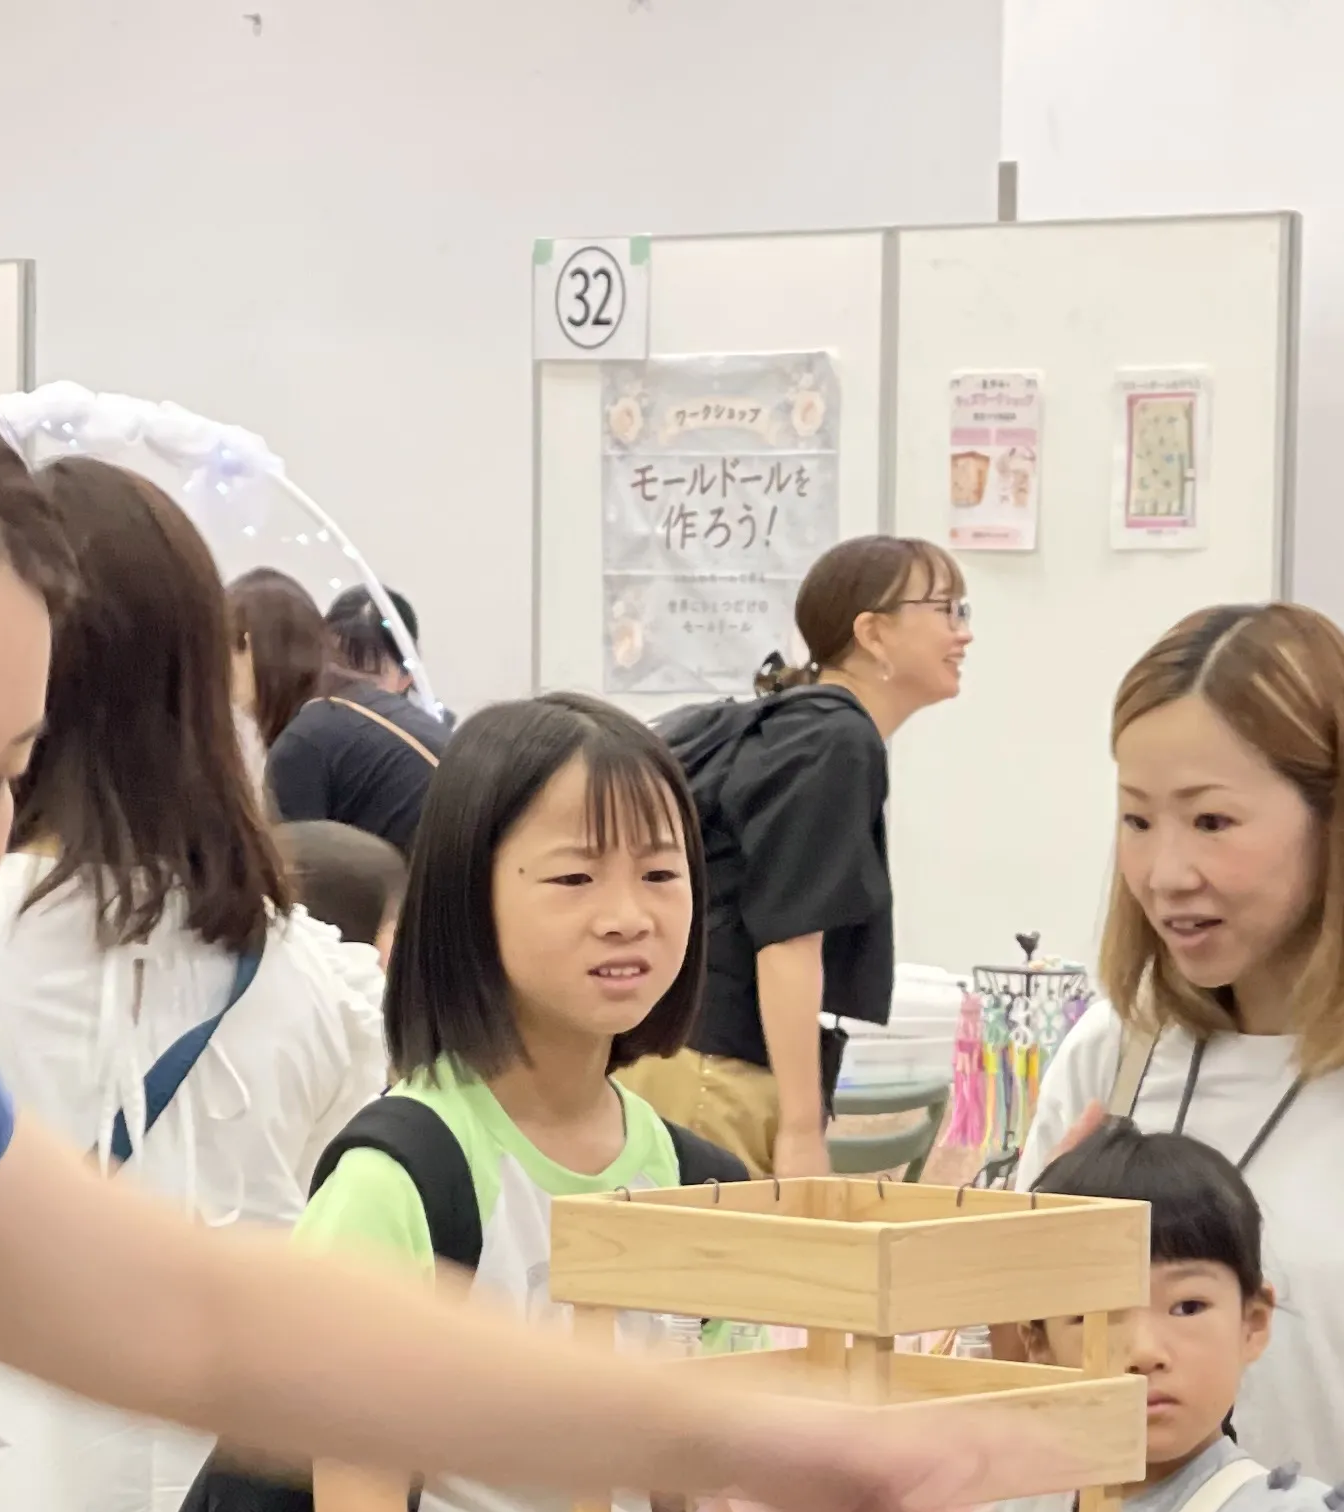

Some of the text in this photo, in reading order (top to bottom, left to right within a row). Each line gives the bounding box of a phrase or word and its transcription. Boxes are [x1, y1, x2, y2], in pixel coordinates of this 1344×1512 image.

[566, 266, 614, 328] 32
[675, 403, 762, 427] ワークショップ
[630, 456, 811, 502] モールドールを
